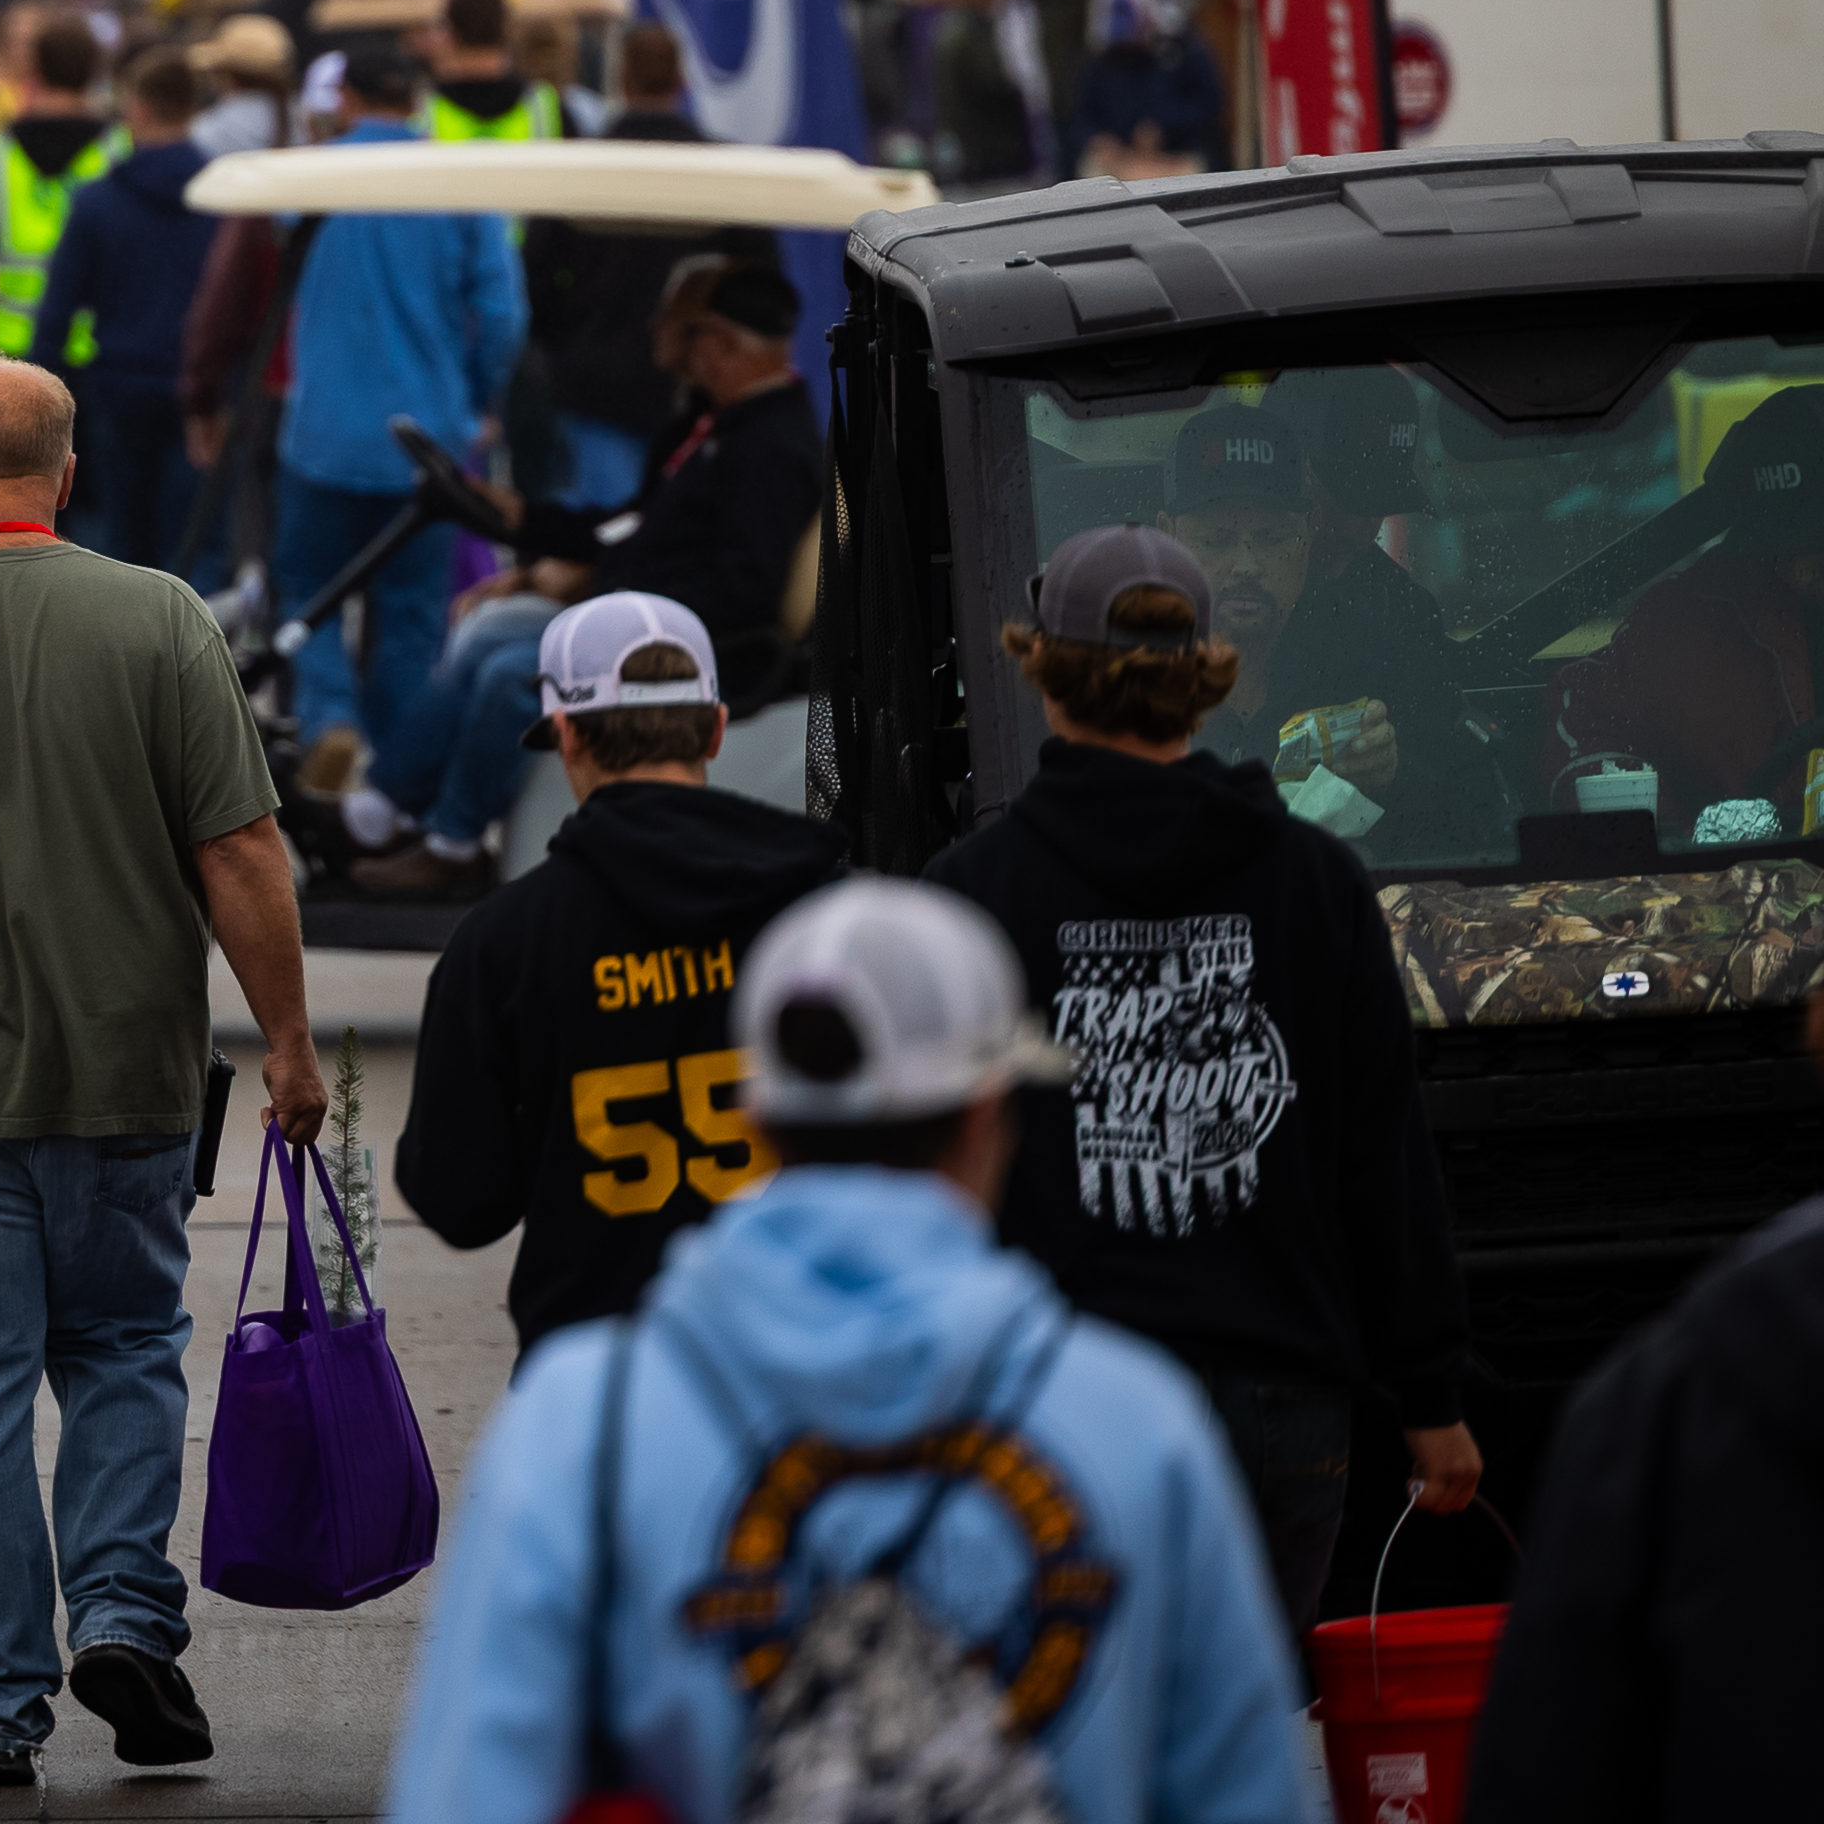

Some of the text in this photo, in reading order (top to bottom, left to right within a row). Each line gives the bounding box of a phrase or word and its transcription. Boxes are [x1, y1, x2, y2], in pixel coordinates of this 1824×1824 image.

[1226, 438, 1274, 464] HHD
[1753, 463, 1801, 491] HHD
[593, 938, 734, 1012] SMITH
[1053, 985, 1174, 1045] TRAP
[1107, 1051, 1269, 1114] SHOOT
[571, 1046, 782, 1218] 55
